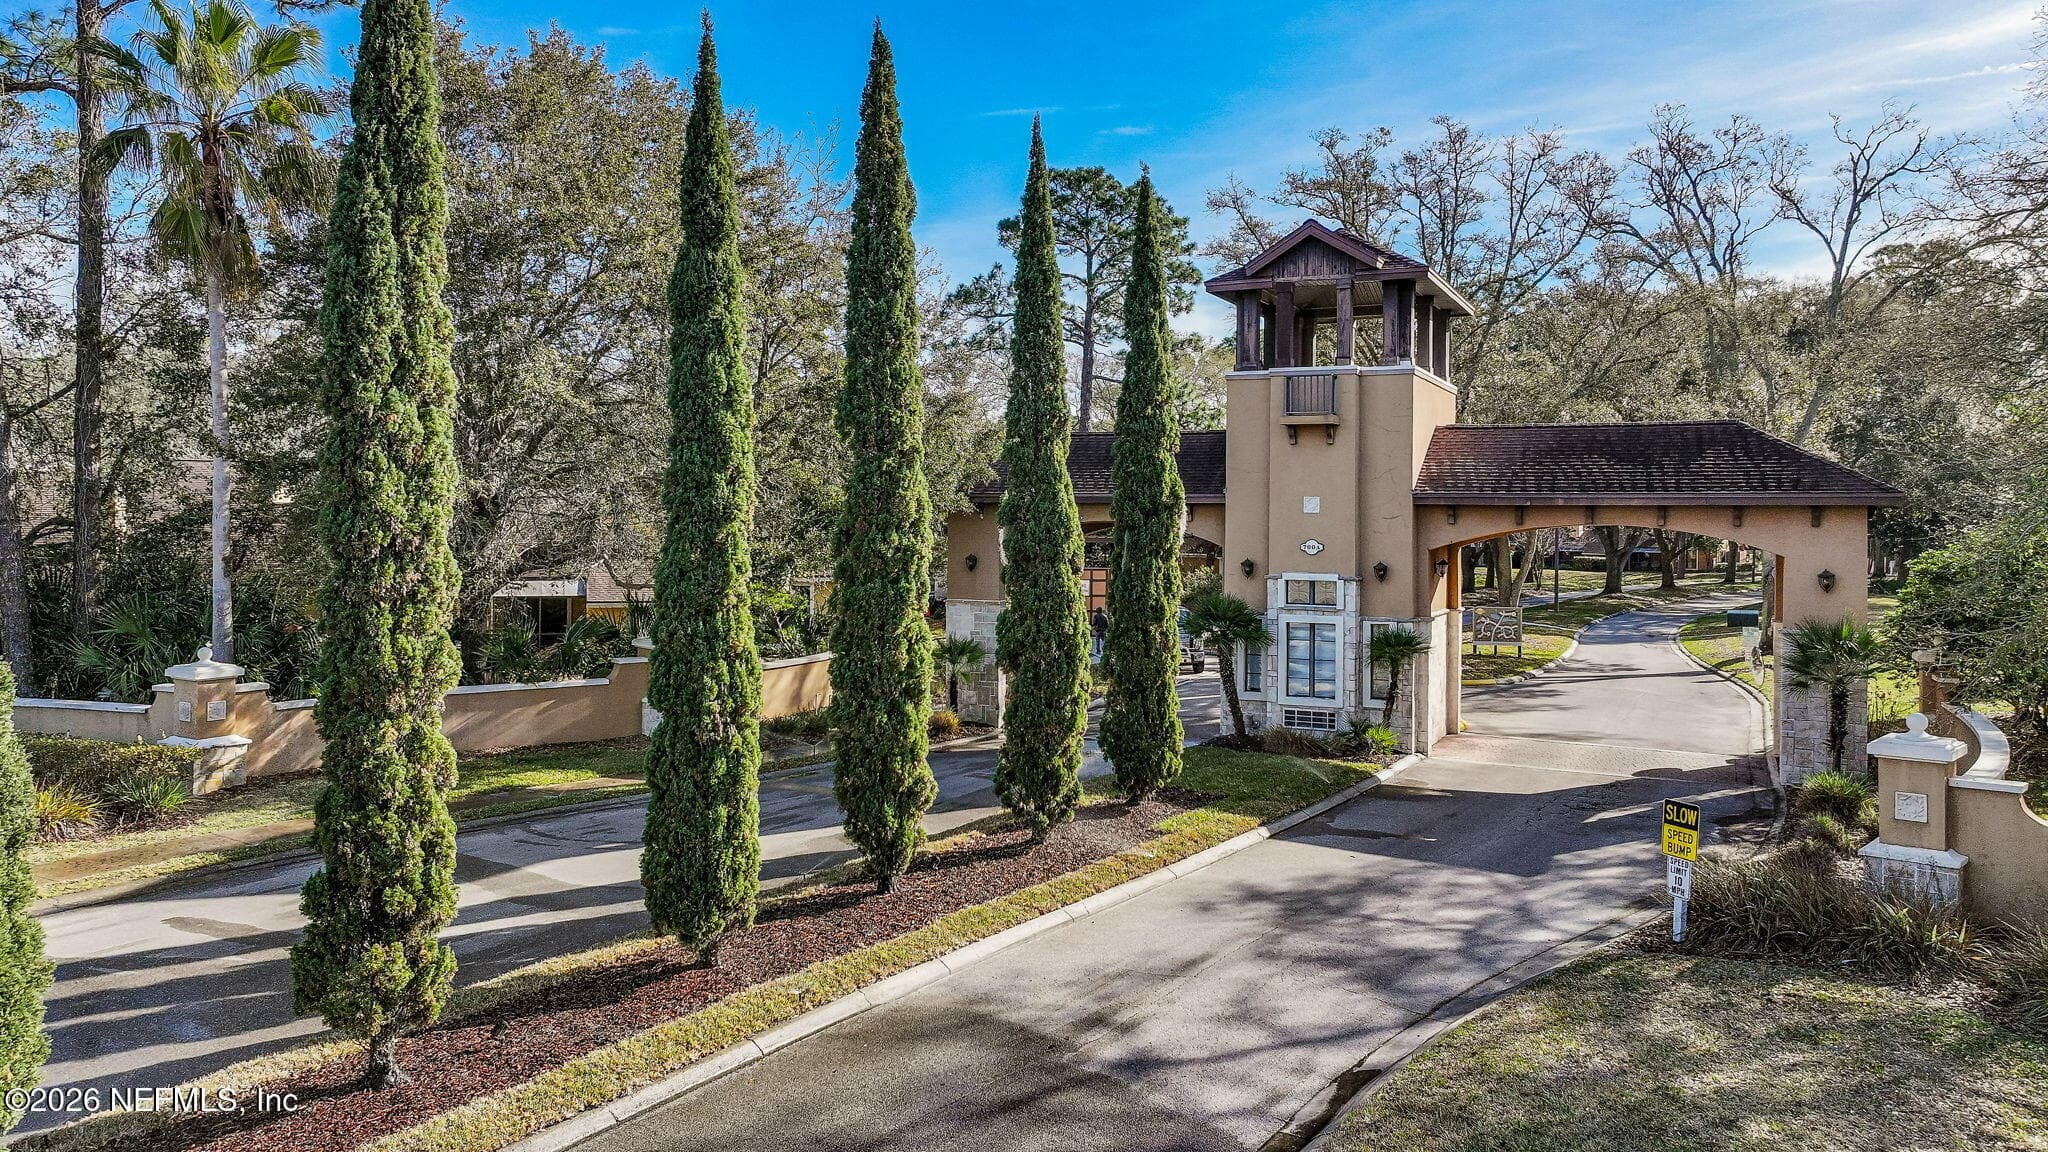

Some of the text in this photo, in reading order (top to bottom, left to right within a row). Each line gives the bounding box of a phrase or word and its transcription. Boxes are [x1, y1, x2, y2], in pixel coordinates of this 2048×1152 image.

[1666, 804, 1697, 826] SLOW
[1667, 828, 1694, 845] SPEED
[1667, 841, 1692, 857] BUMP
[1670, 856, 1689, 869] SPEED
[1670, 865, 1687, 877] LIMIT
[1674, 875, 1683, 887] 10
[1671, 885, 1685, 896] MPH
